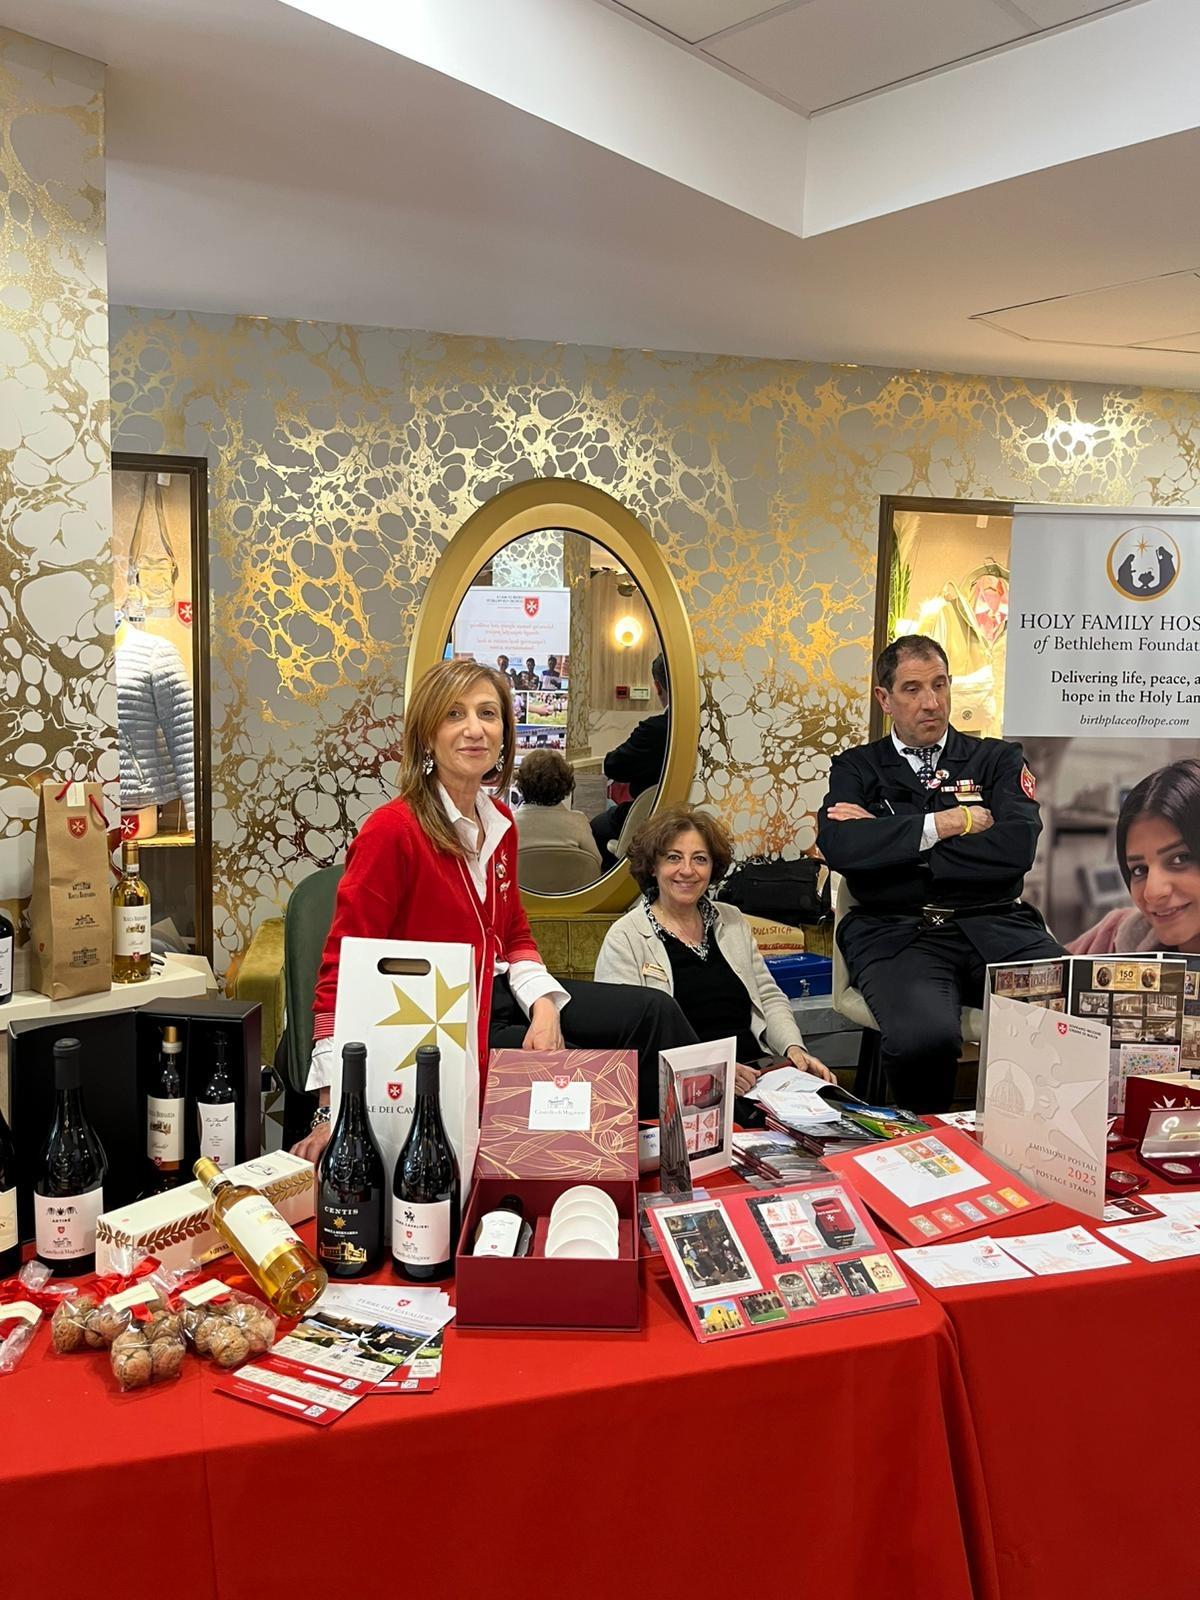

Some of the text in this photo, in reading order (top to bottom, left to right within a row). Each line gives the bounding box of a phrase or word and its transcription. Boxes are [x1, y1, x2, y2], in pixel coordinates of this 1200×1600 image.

[1020, 613, 1200, 631] HOLY FAMILY HOS
[1033, 635, 1200, 655] of Bethlehem Foundat
[1051, 670, 1118, 687] Delivering
[1122, 670, 1146, 686] life,
[1150, 674, 1190, 687] peace,
[1062, 689, 1094, 705] hope
[1098, 689, 1111, 702] in
[1115, 690, 1135, 703] the
[1140, 690, 1172, 706] Holy
[1080, 714, 1189, 728] birthplaceofhope.com
[1120, 970, 1134, 978] 150
[379, 1105, 394, 1114] DEI
[1029, 1142, 1097, 1172] EMISSIONI POSTALI
[1036, 1169, 1096, 1198] POSTAGE STAMPS
[1068, 1166, 1096, 1186] 2025
[324, 1205, 359, 1215] CENTIS
